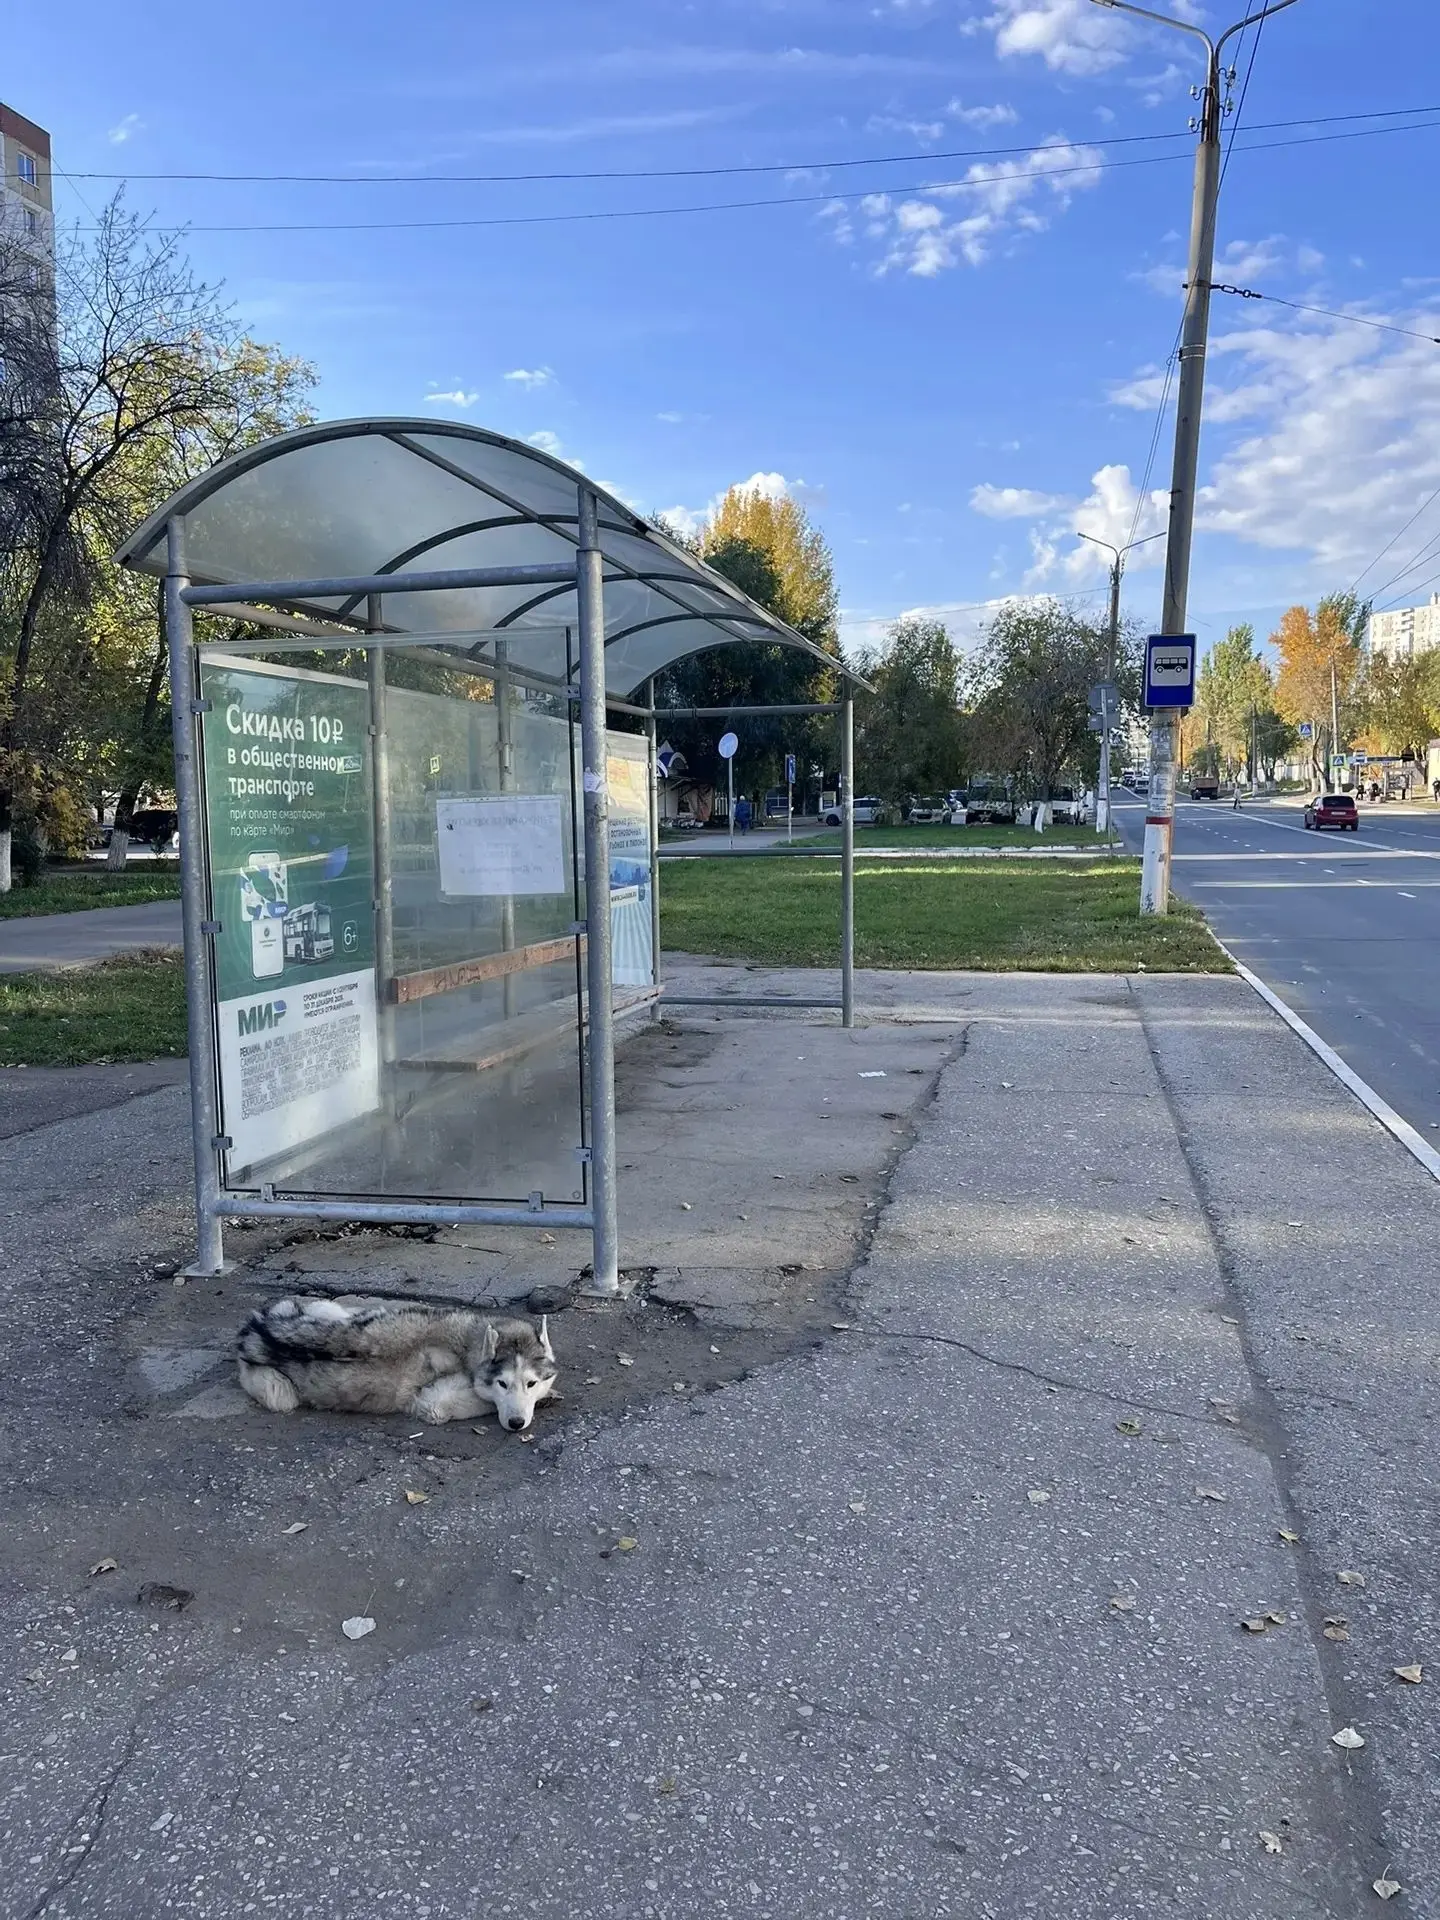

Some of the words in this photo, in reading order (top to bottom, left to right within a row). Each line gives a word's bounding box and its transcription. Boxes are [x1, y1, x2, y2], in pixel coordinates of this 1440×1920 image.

[226, 704, 304, 743] Скидка
[310, 715, 343, 744] 10₽
[227, 747, 237, 764] в
[228, 776, 314, 798] транспорте
[230, 809, 246, 821] при
[248, 809, 277, 820] оплате
[279, 810, 325, 820] смартфоном
[230, 826, 241, 836] по
[243, 826, 267, 837] карте
[344, 926, 357, 946] 6+
[237, 1000, 288, 1037] МИР
